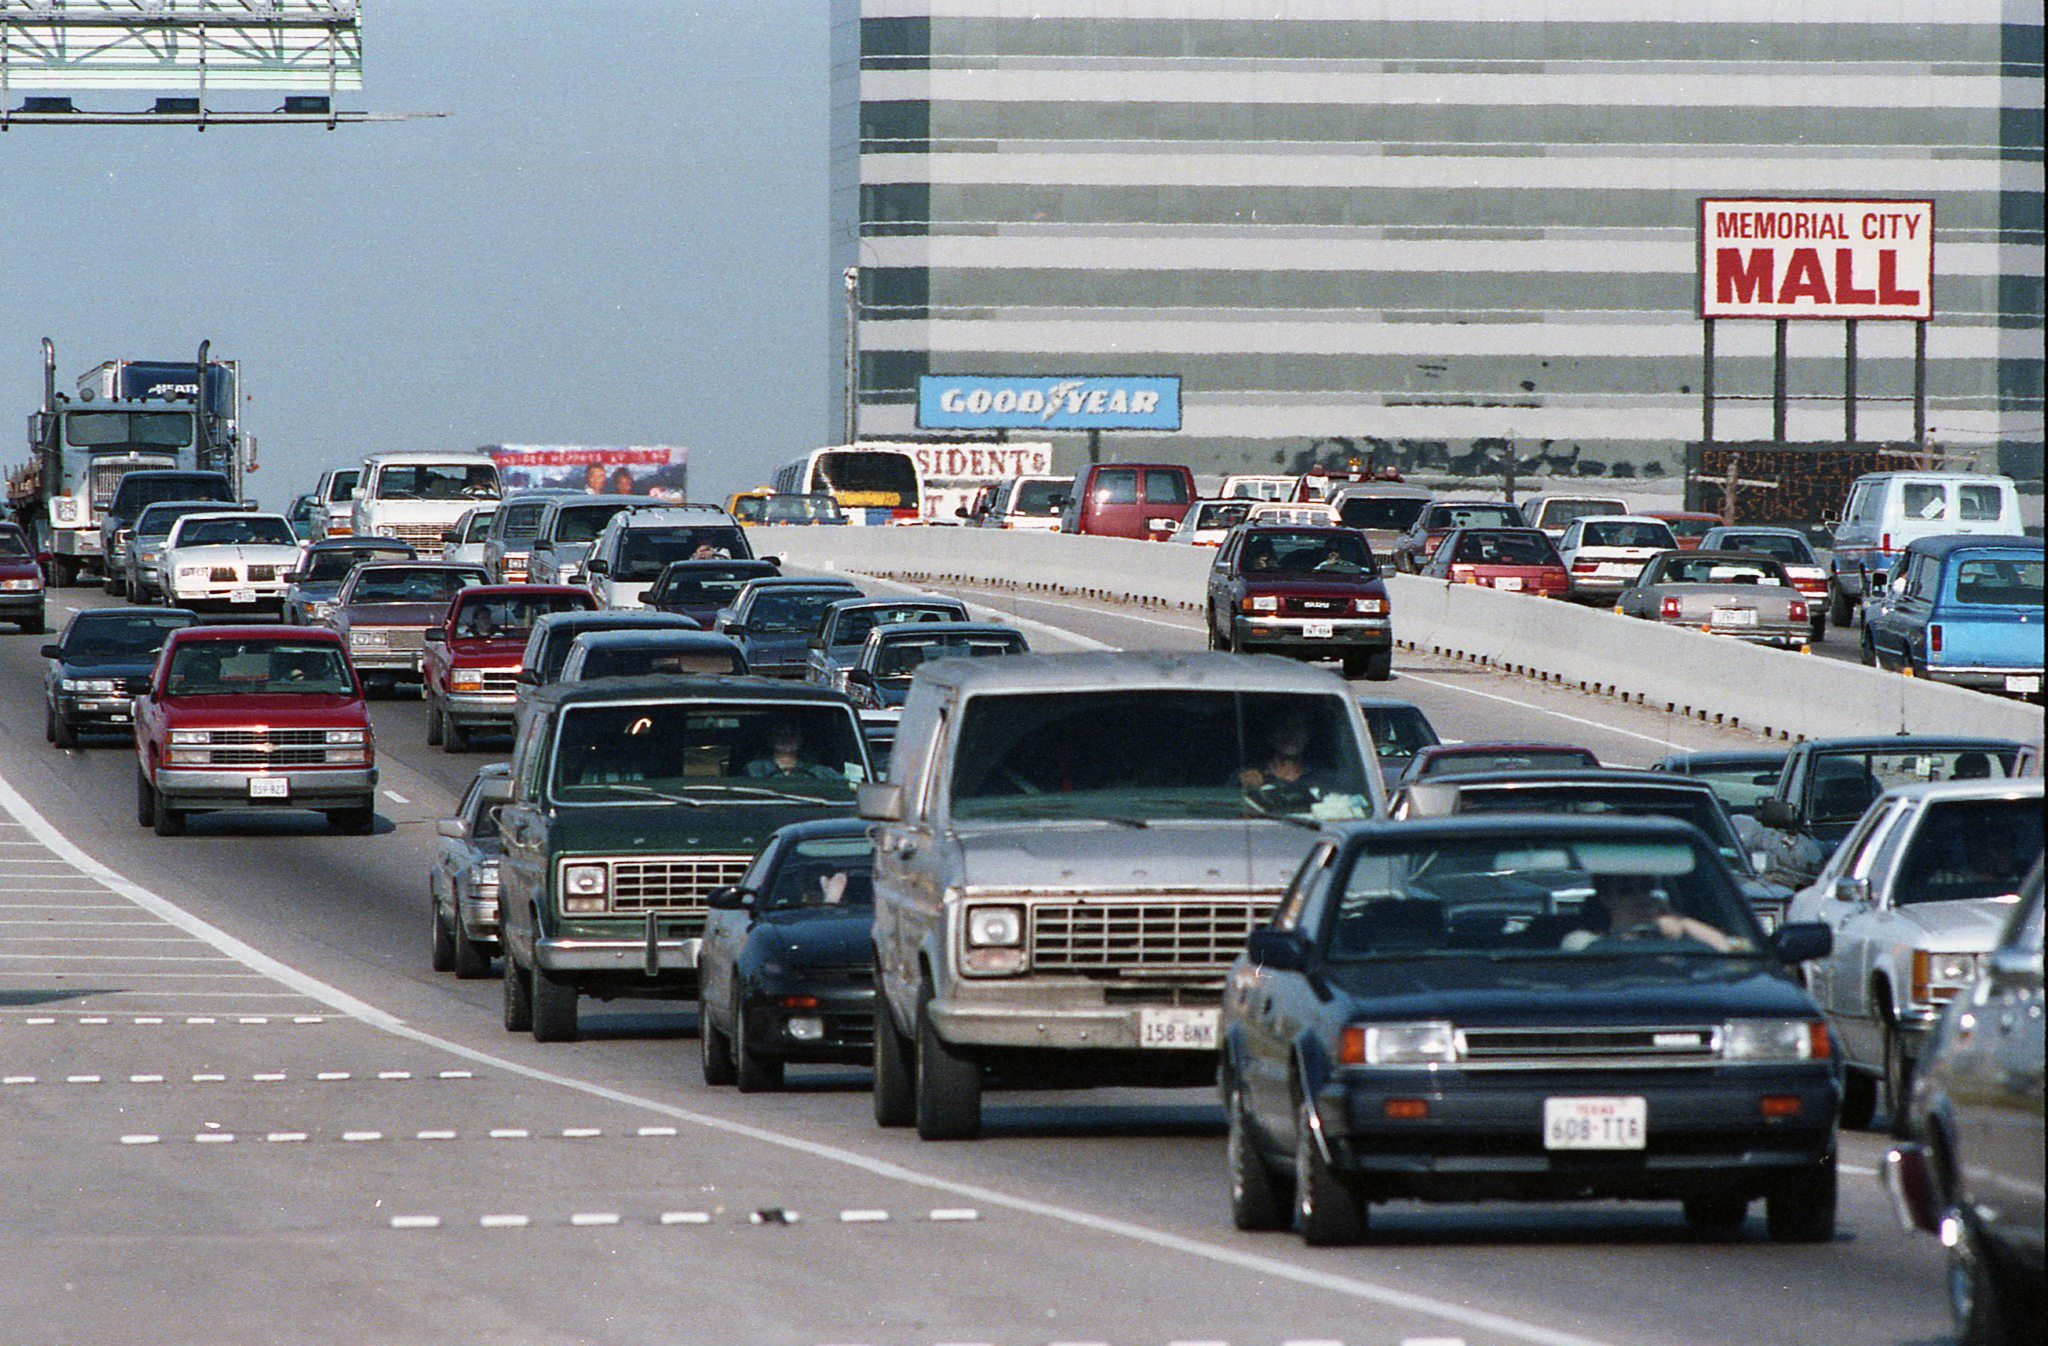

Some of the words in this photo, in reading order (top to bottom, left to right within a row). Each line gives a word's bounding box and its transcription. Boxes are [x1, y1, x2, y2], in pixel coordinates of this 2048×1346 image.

[1716, 212, 1849, 239] MEMORIAL
[1862, 213, 1921, 239] CITY
[1716, 248, 1920, 305] MALL
[940, 387, 1160, 415] GOODYEAR
[916, 448, 1030, 476] SIDENT
[1702, 451, 1806, 473] PRVATE
